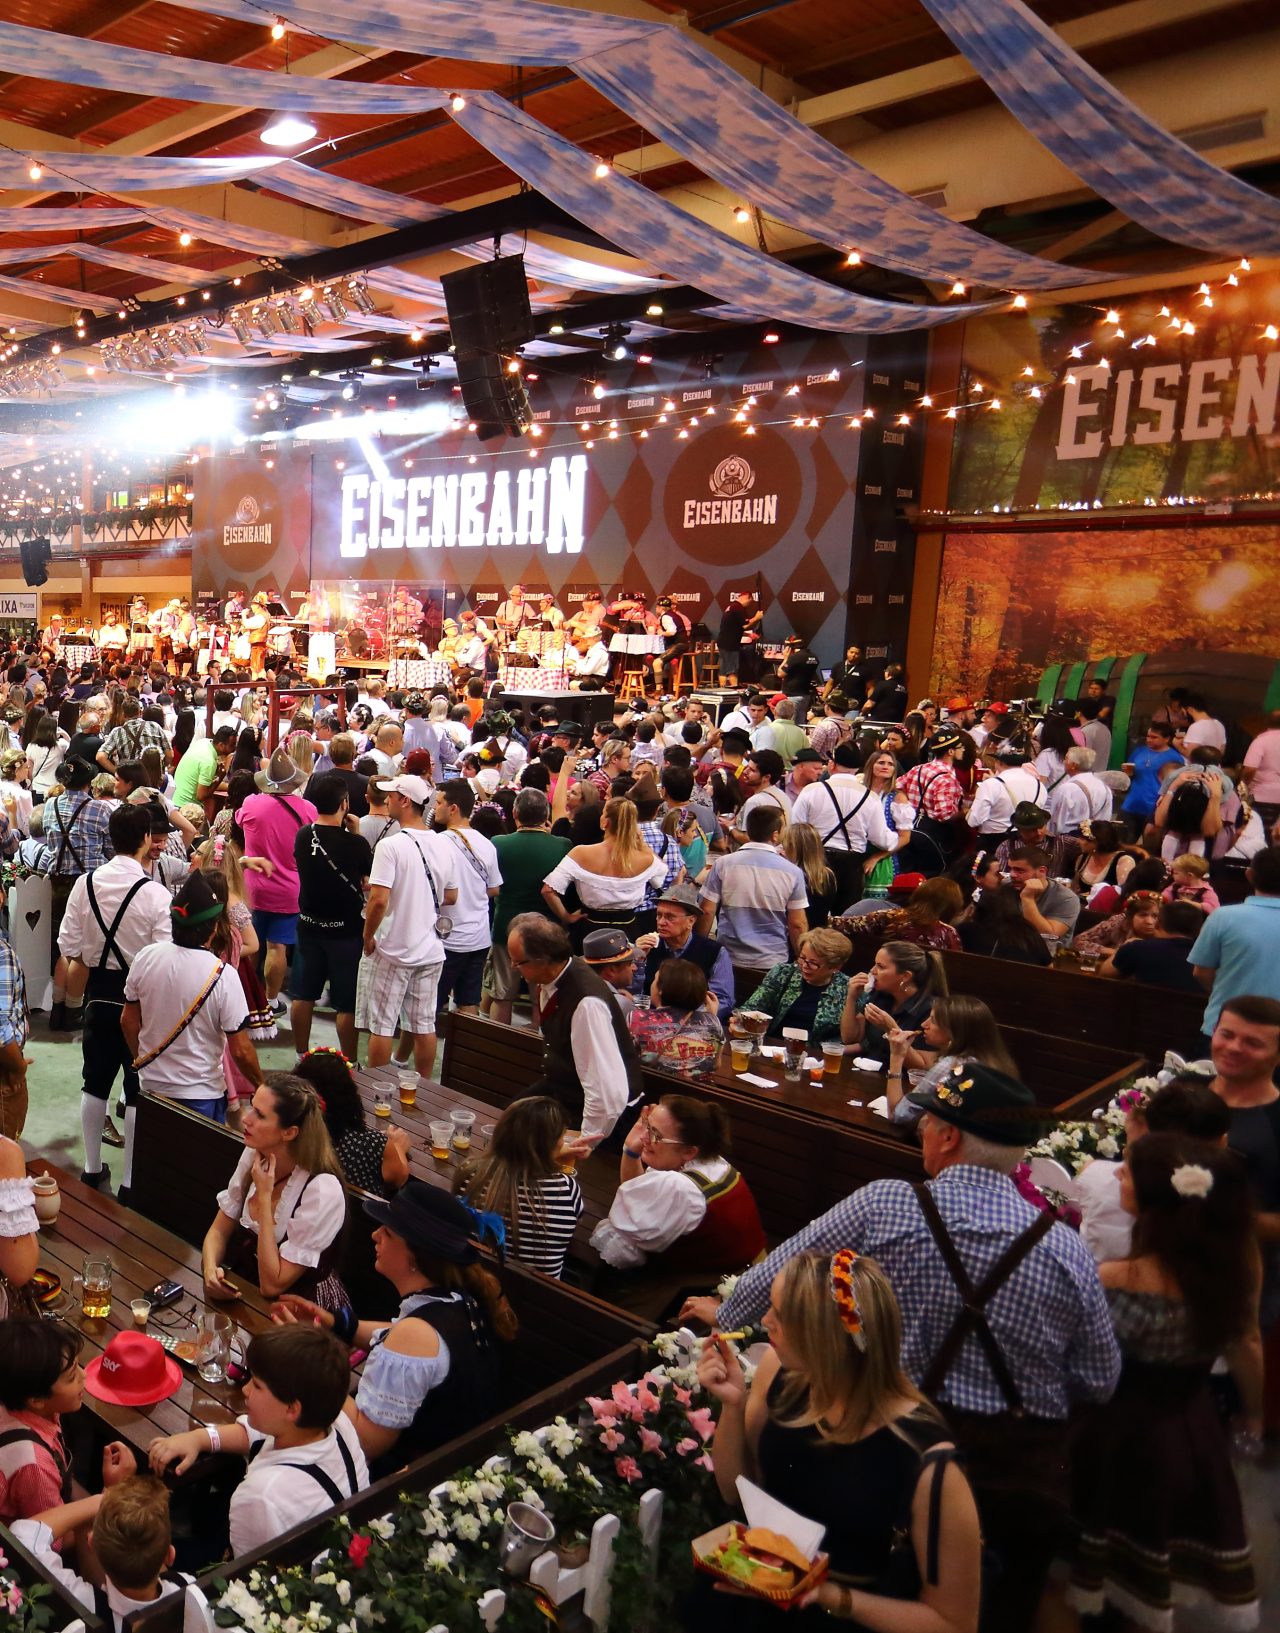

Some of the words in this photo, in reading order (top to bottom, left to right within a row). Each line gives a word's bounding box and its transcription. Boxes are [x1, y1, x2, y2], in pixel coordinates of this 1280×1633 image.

[340, 455, 587, 557] EISENBAHN
[683, 494, 777, 528] EISENBAHN
[223, 523, 271, 545] EISENBAHN
